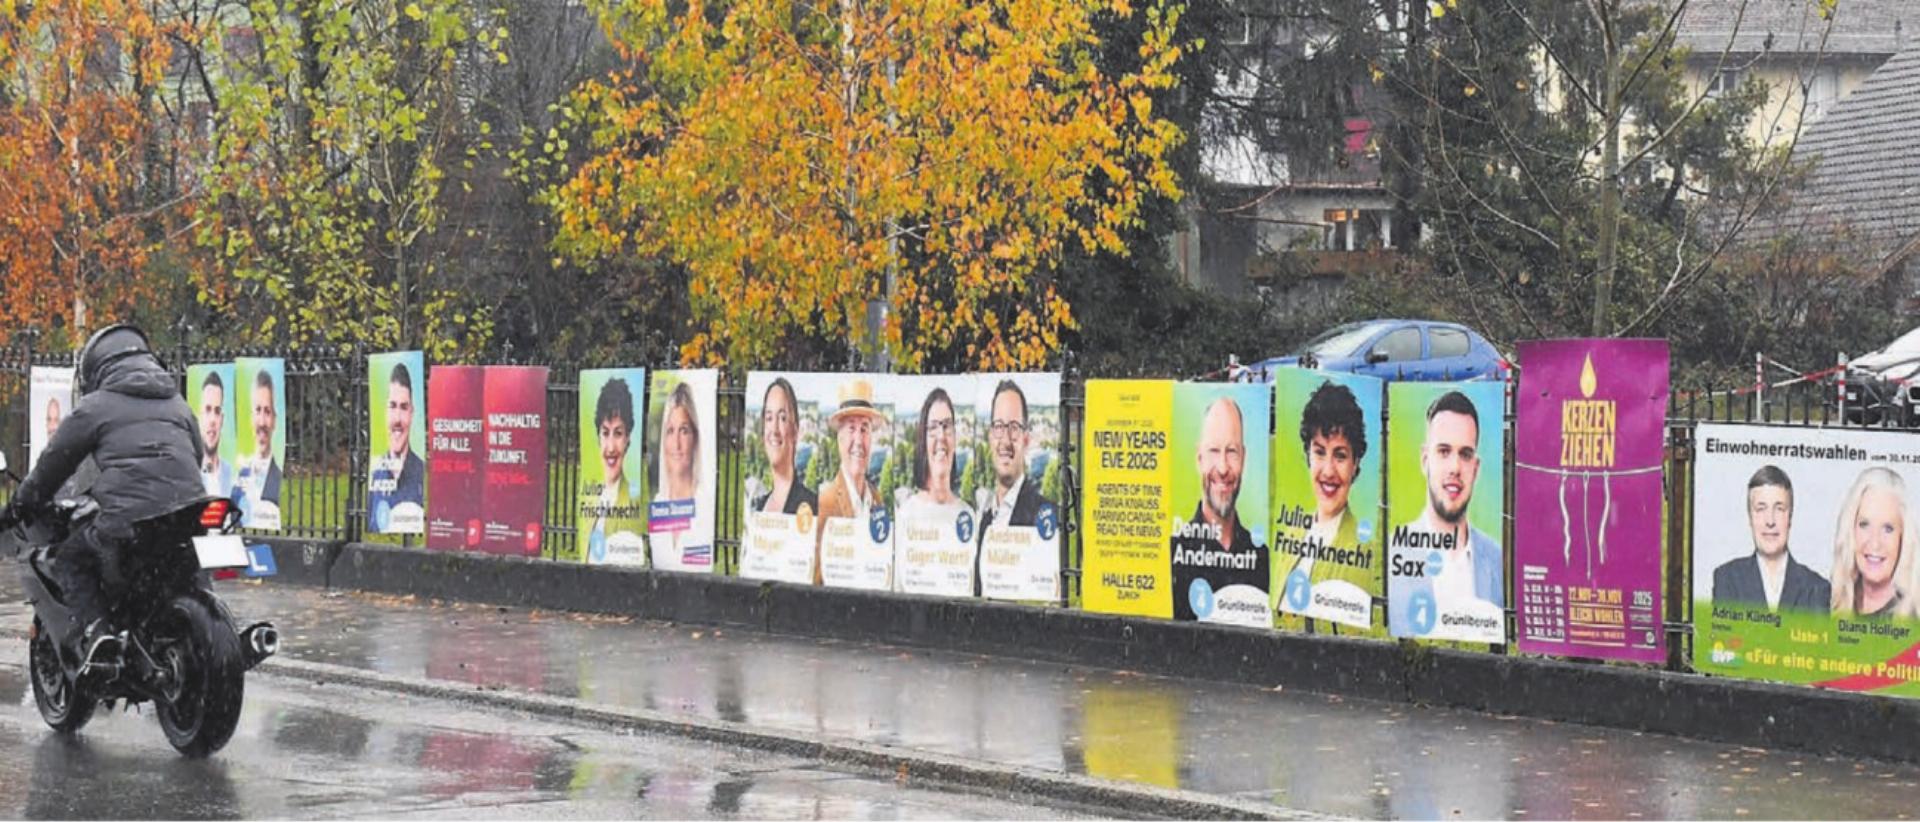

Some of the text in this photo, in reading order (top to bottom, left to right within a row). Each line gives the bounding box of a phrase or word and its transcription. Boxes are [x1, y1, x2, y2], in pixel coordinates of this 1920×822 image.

[432, 418, 483, 433] GESUNDHEIT
[488, 413, 541, 429] NACHHALTIG
[1562, 400, 1616, 433] KERZEN
[432, 434, 472, 452] FÜR ALLE.
[488, 431, 512, 446] IN DIE
[1093, 431, 1166, 449] NEW YEARS
[489, 449, 529, 464] ZUKUNFT.
[1560, 433, 1615, 467] ZIEHEN
[1705, 437, 1867, 460] Einwohnerratswahlen
[1101, 451, 1158, 470] EVE 2025
[581, 481, 603, 496] Julia
[1096, 483, 1162, 497] AGENTS OF TIME
[580, 501, 640, 519] Frischknecht
[1092, 510, 1126, 522] MARINO
[1127, 512, 1156, 523] CANAL
[1276, 504, 1312, 530] Julia
[876, 521, 887, 541] 2
[961, 524, 970, 541] 2
[1042, 517, 1052, 537] 2
[1096, 523, 1162, 537] READ THE NEWS
[1172, 516, 1223, 541] Dennis
[1392, 525, 1458, 550] Manuel
[1173, 543, 1257, 570] Andermatt
[1274, 531, 1372, 569] Frischknecht
[248, 550, 268, 572] L
[1391, 553, 1425, 577] Sax
[1101, 573, 1155, 590] HALLE 622
[1632, 590, 1653, 606] 2025
[1712, 607, 1744, 622] Adrian
[1747, 610, 1781, 628] Kündig
[1790, 628, 1819, 643] Liste
[1838, 619, 1910, 640] Diana Holliger
[1745, 648, 1777, 666] «Für
[1783, 653, 1815, 670] eine
[1819, 659, 1872, 677] andere
